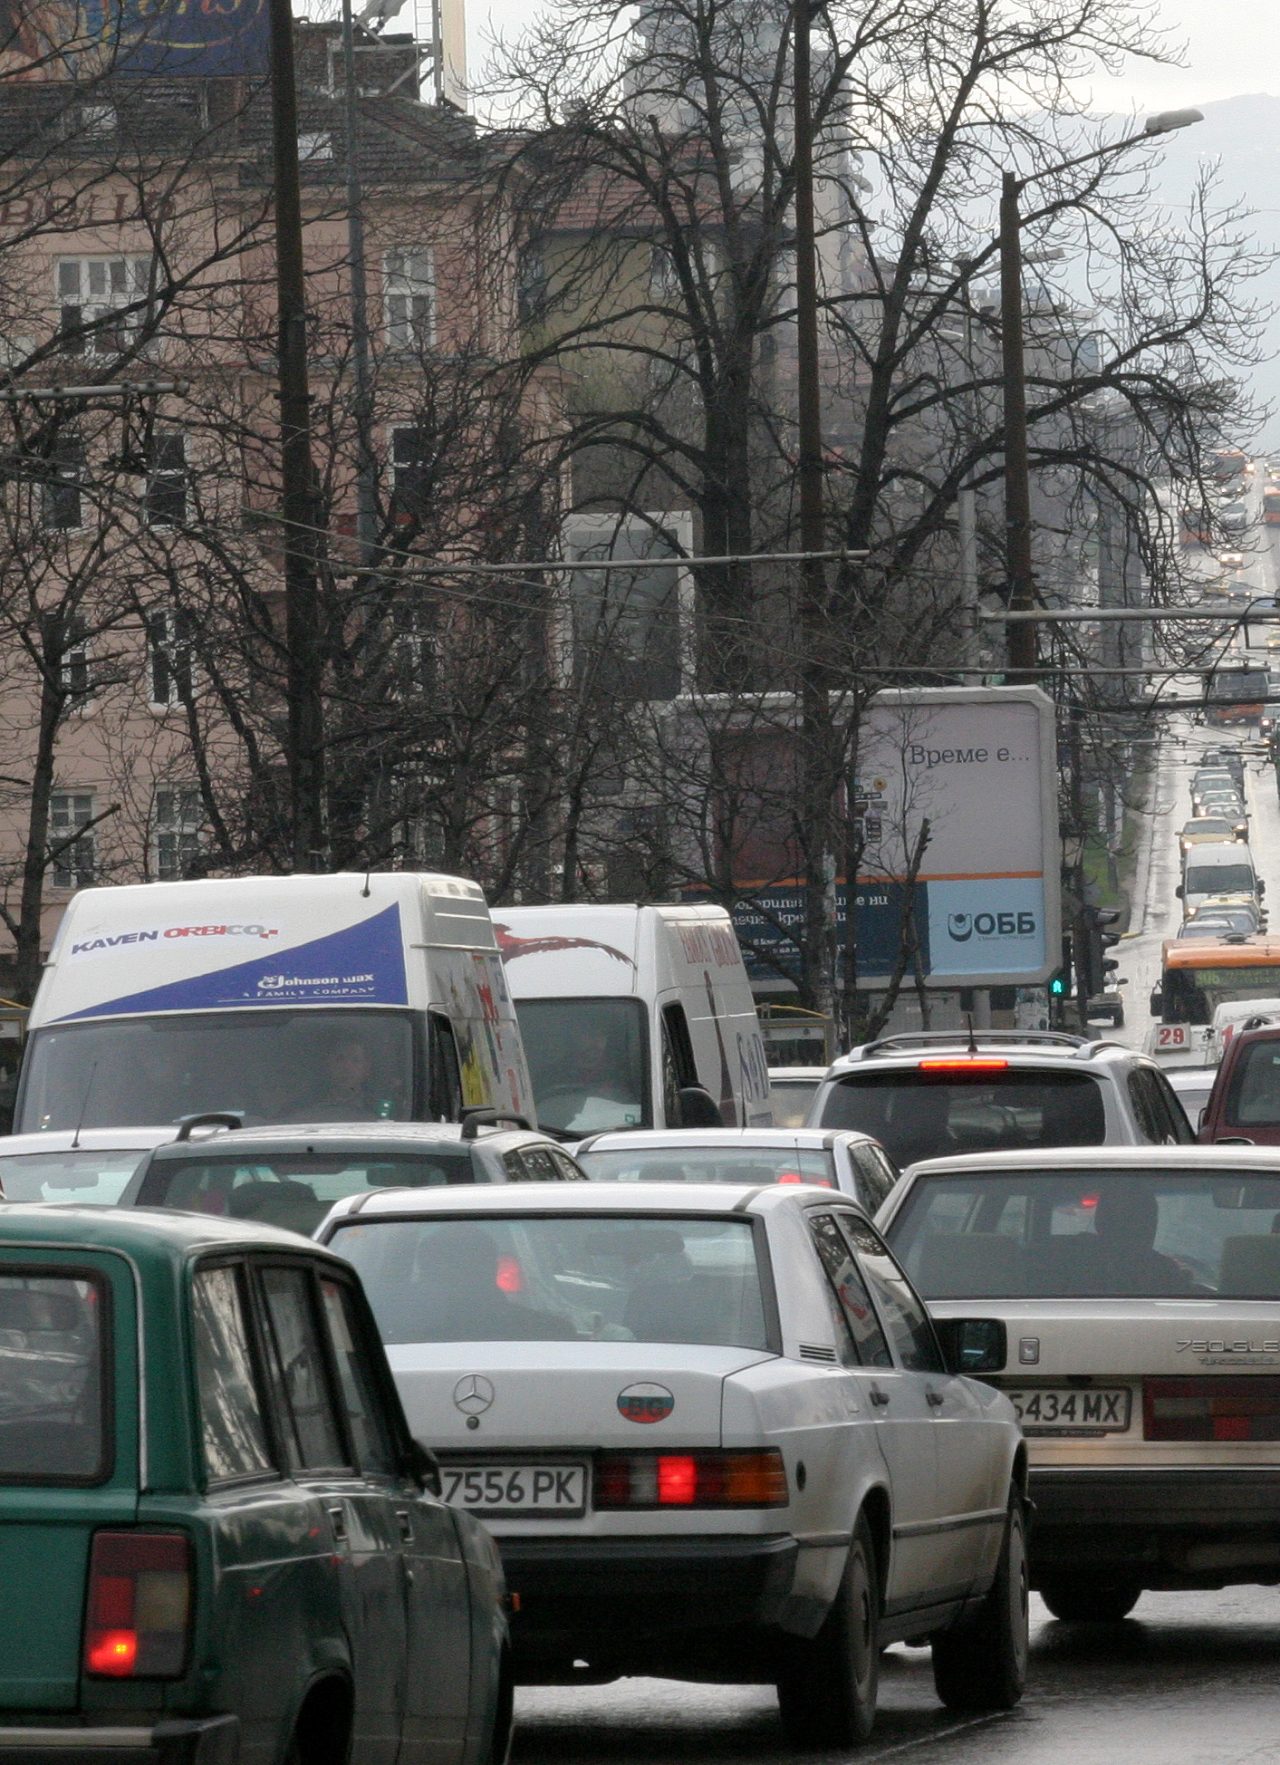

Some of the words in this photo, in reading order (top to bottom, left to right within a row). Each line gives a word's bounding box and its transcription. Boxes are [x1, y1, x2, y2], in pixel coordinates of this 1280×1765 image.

[911, 745, 988, 768] Време
[974, 911, 1036, 935] ОББ
[71, 930, 158, 954] KAVEN
[163, 923, 264, 938] ORBICO
[258, 974, 339, 988] Johnson
[1159, 1029, 1184, 1046] 29
[1082, 1393, 1120, 1422] MX
[444, 1470, 525, 1504] 7556
[533, 1470, 577, 1504] PK
